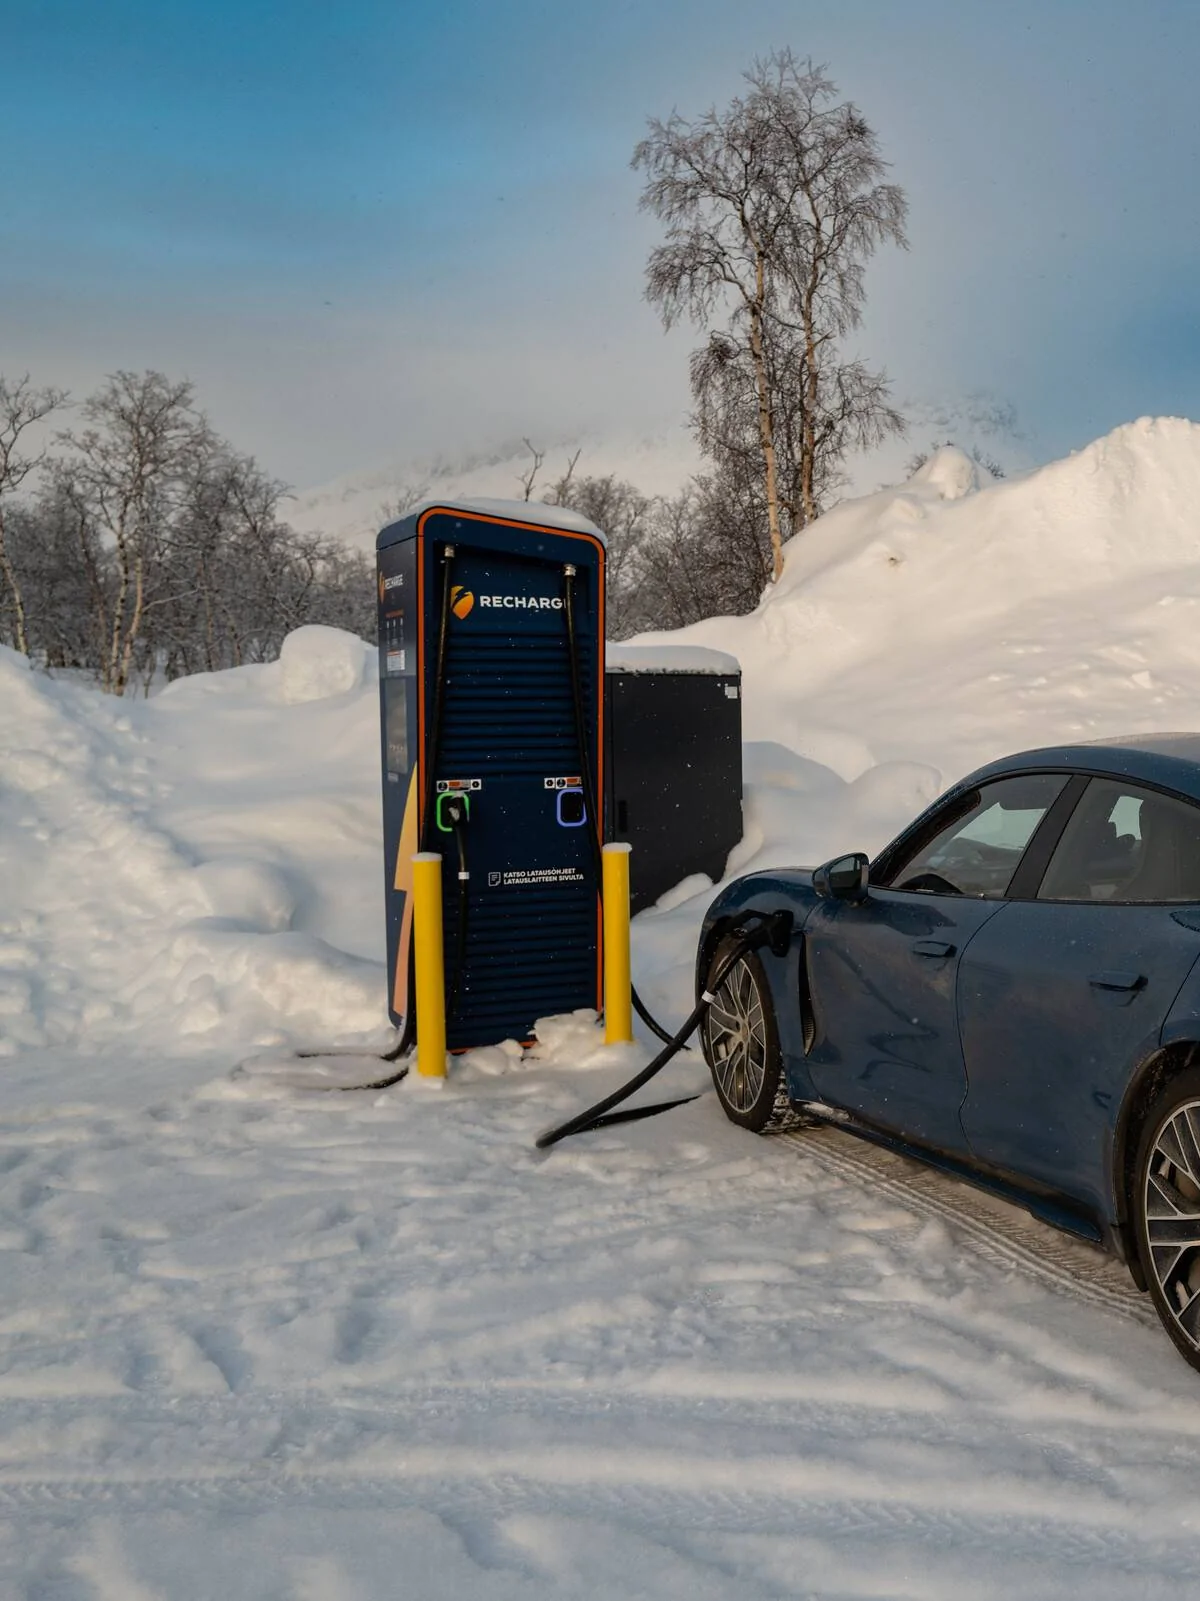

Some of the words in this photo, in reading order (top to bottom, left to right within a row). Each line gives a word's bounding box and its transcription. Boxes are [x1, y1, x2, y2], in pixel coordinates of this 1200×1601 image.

[479, 595, 567, 609] RECHARG
[503, 876, 558, 885] LATAUSLAITTEEN
[558, 873, 585, 881] SIVULTA
